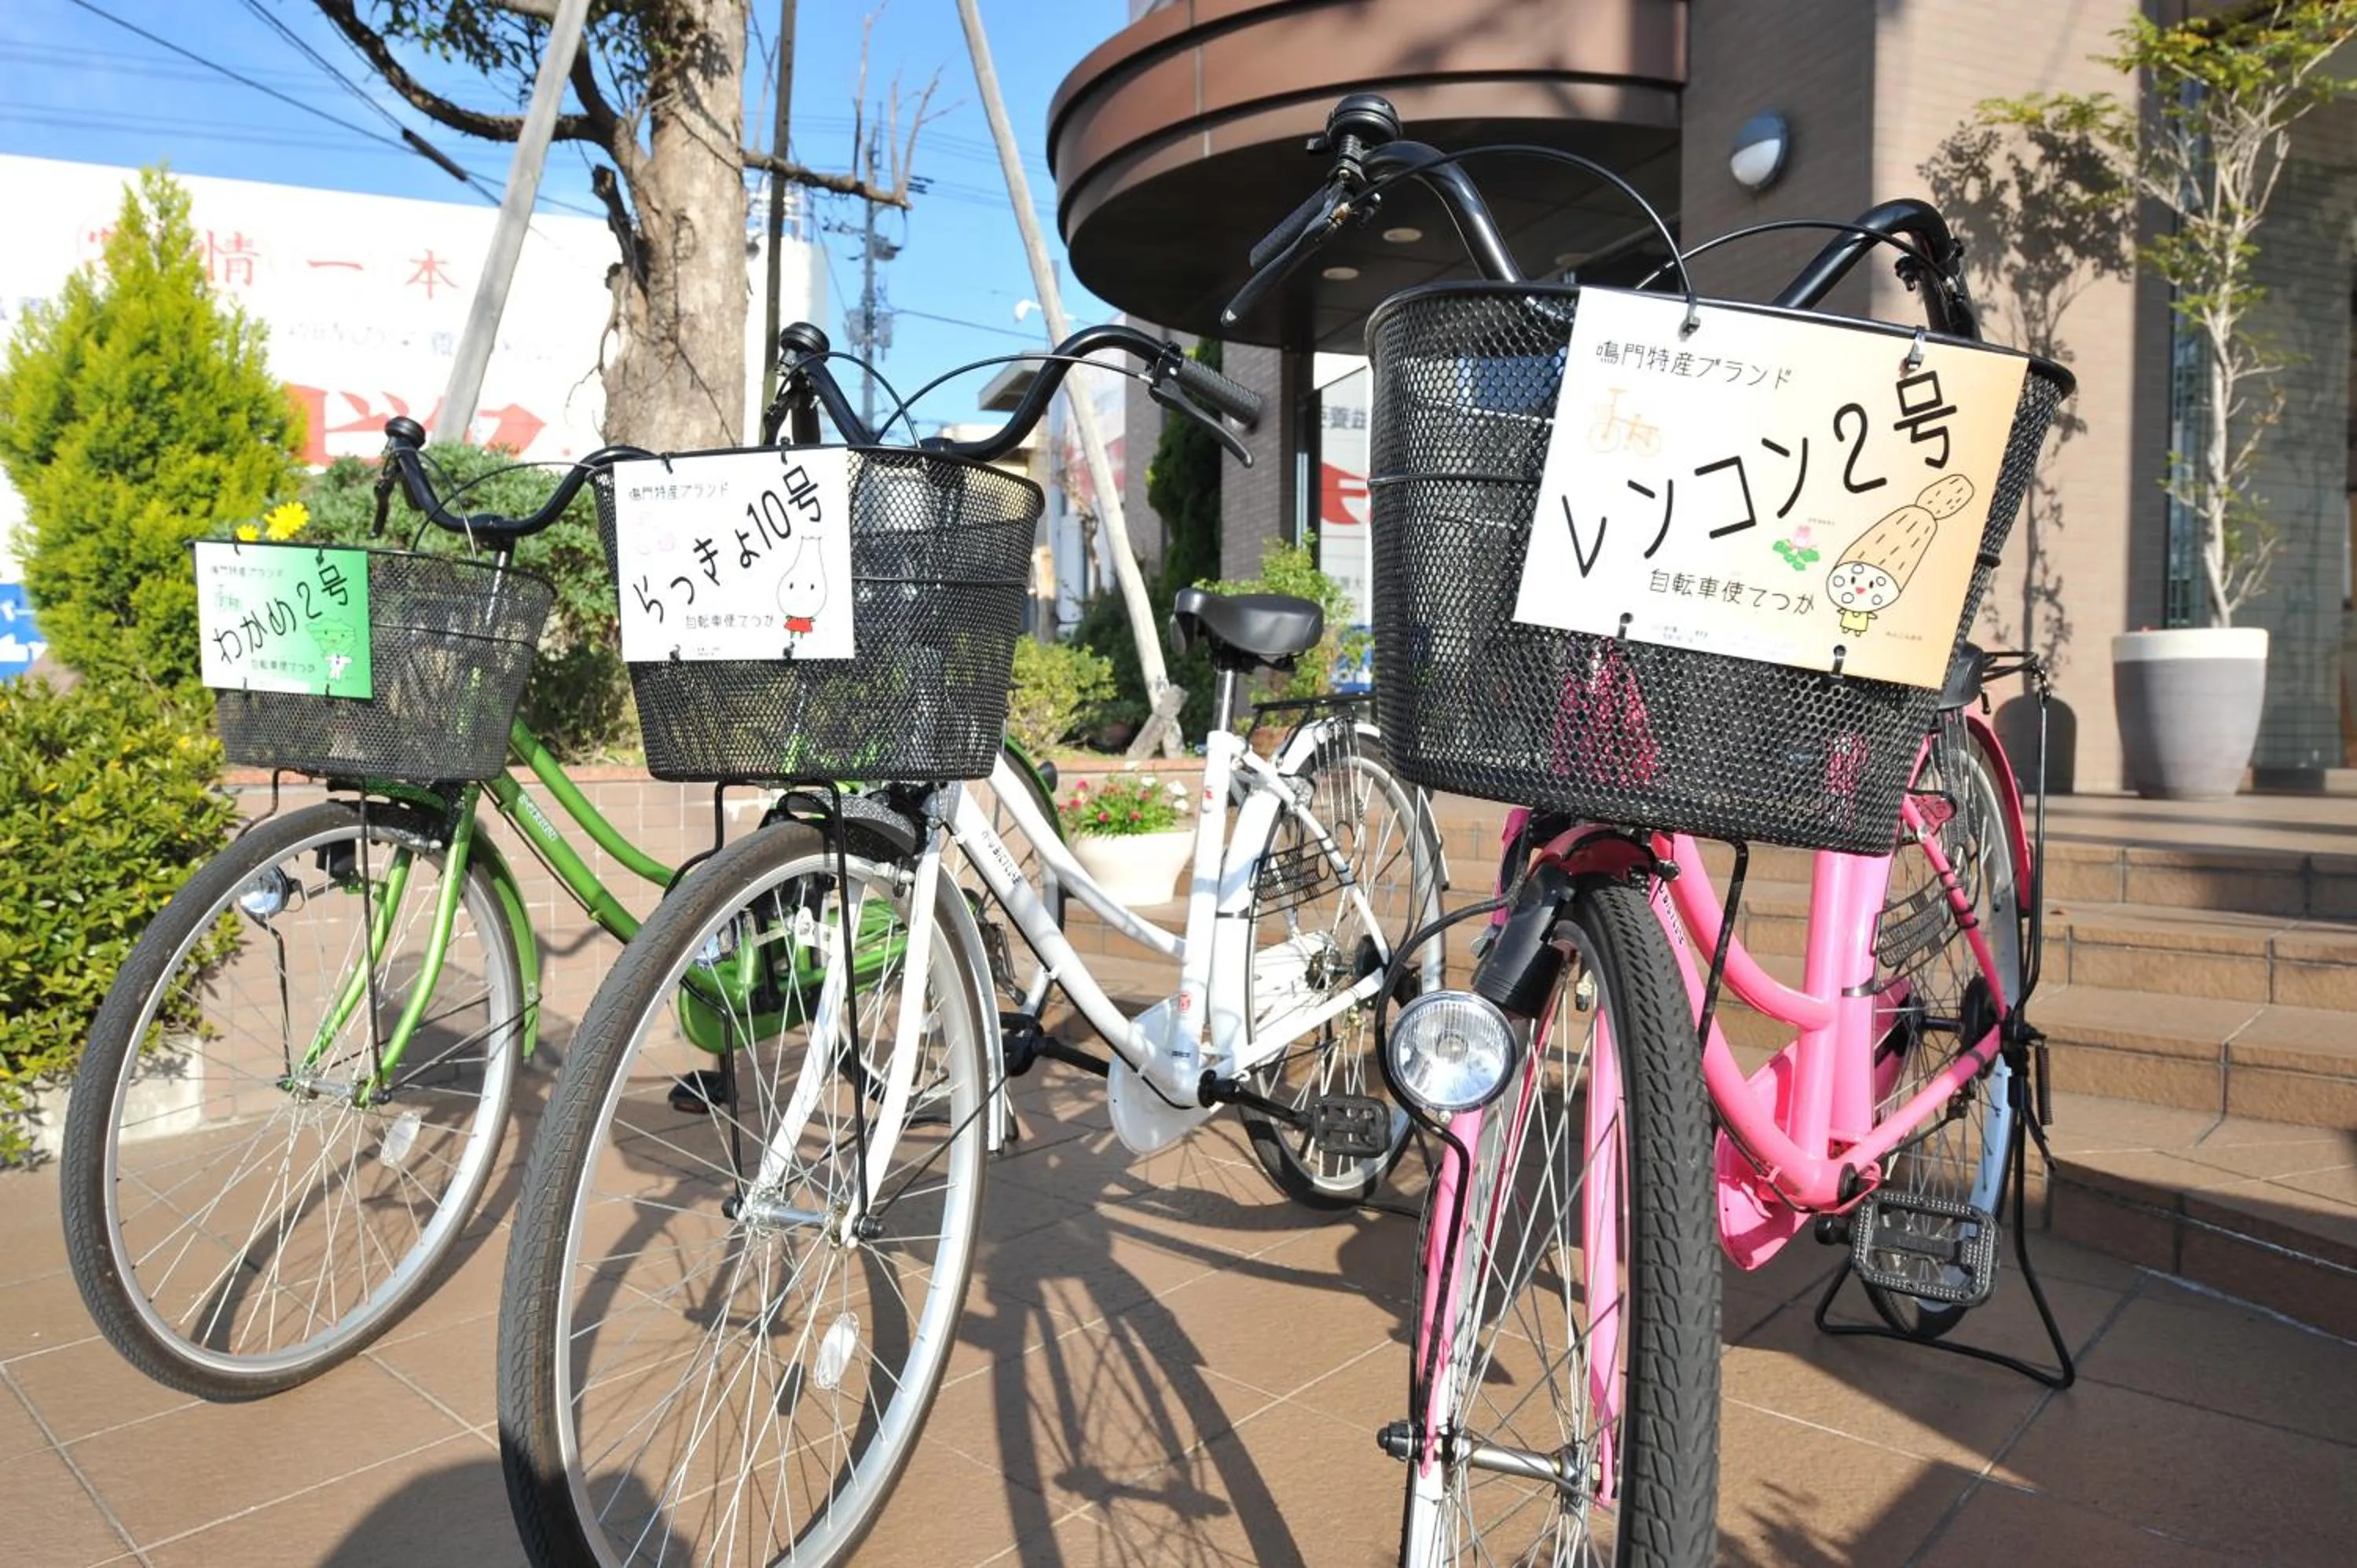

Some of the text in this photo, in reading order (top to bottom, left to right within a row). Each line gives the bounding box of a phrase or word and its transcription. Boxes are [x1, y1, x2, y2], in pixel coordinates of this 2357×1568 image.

[1596, 340, 1792, 390] 鳴門特産ブランド
[1562, 371, 1958, 578] レンコン2号
[212, 564, 348, 665] わかめ2号
